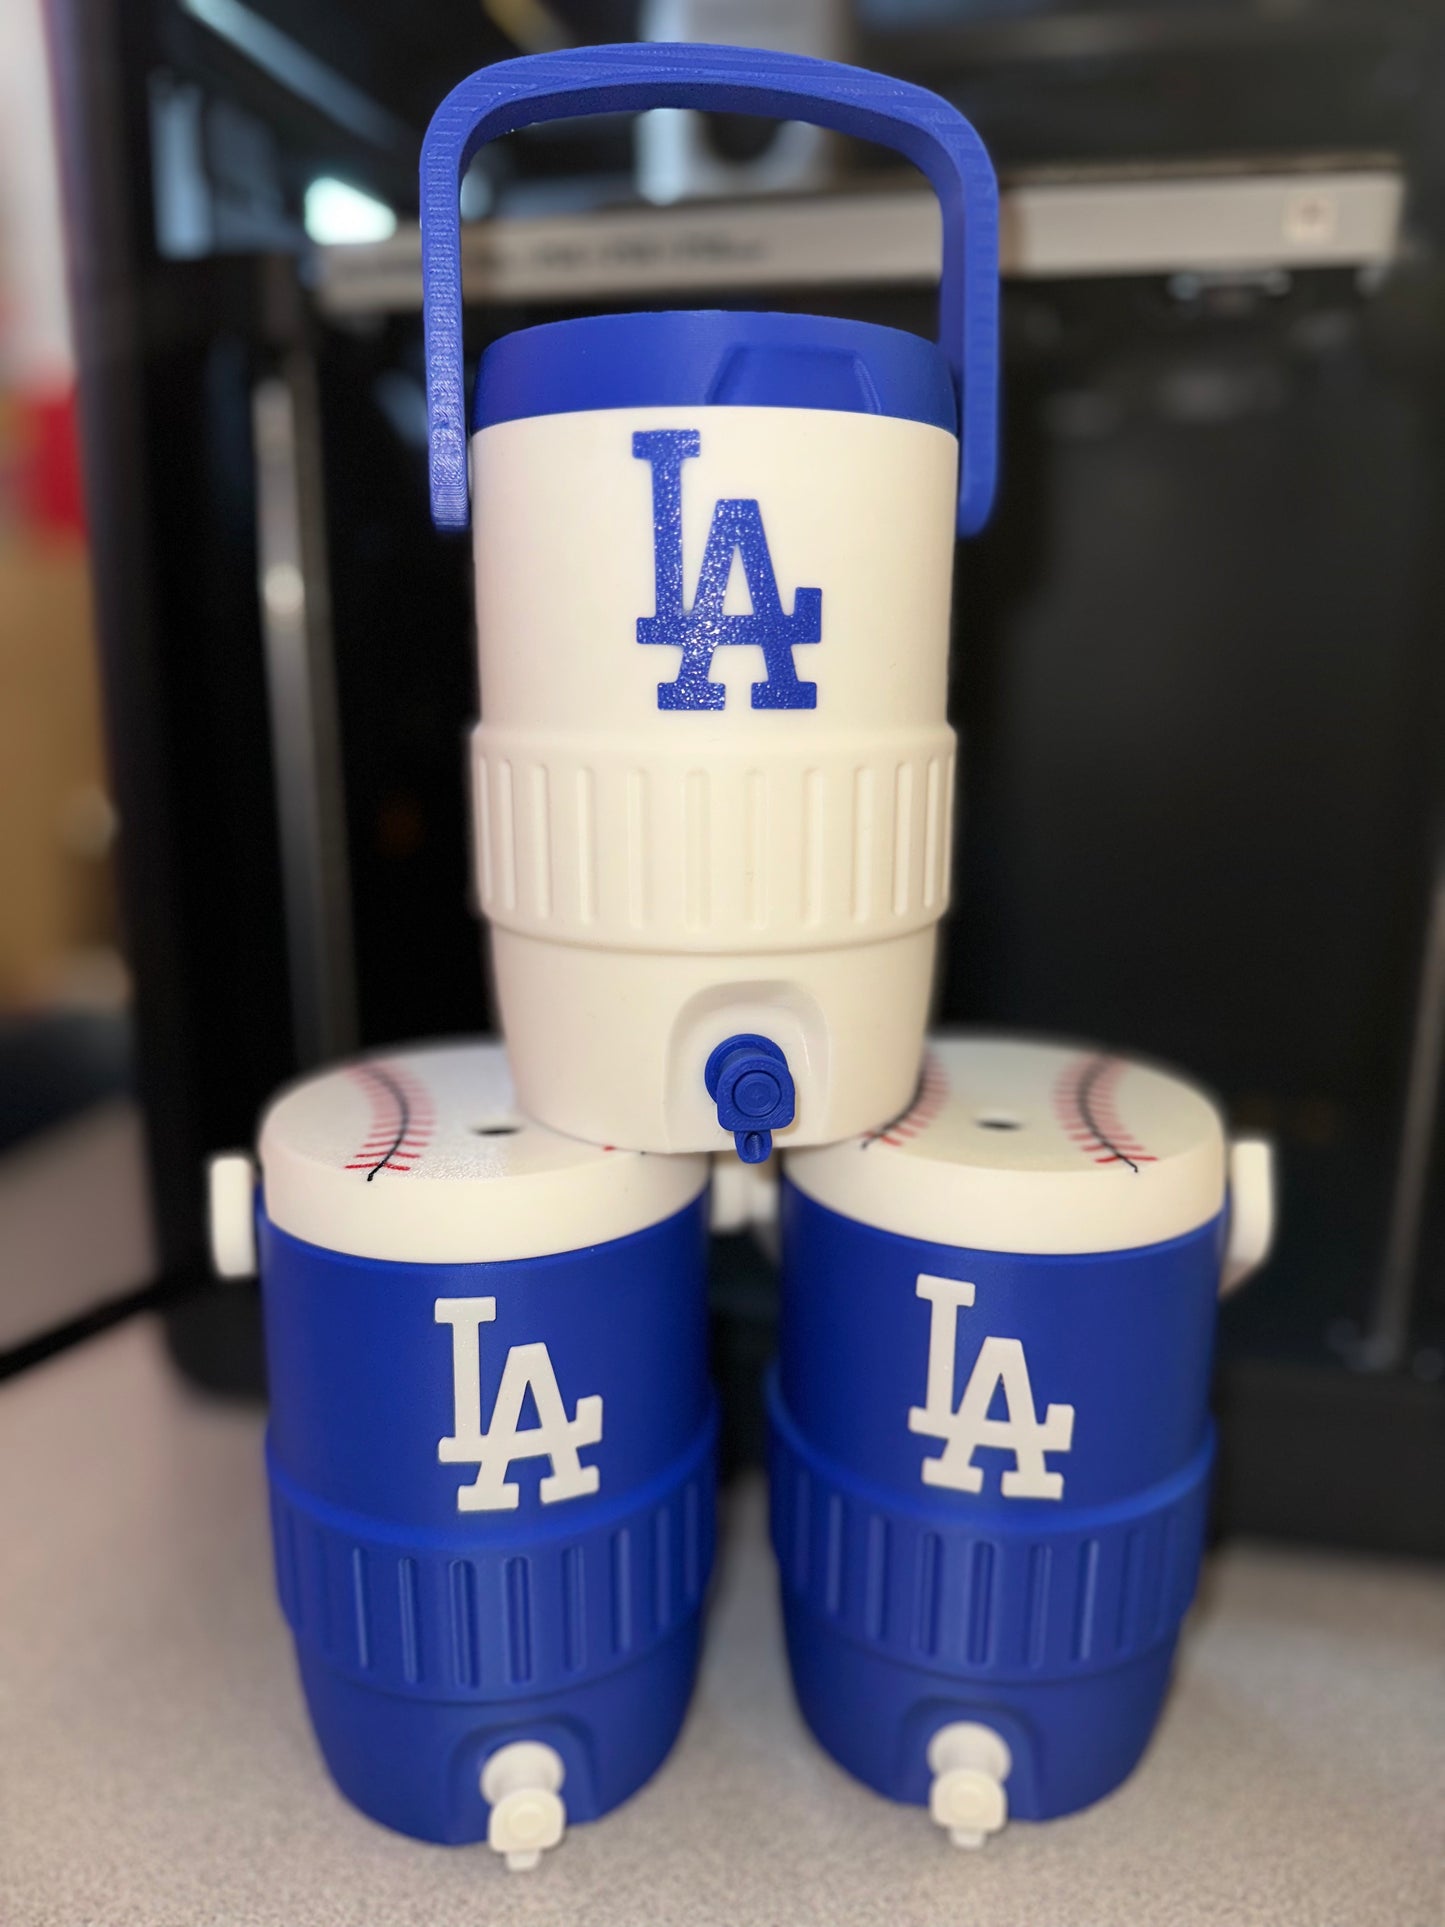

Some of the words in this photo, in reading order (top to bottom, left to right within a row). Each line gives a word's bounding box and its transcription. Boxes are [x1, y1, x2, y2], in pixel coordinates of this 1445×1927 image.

[632, 429, 822, 710] LA
[435, 1296, 603, 1512] LA
[908, 1273, 1075, 1501] LA
